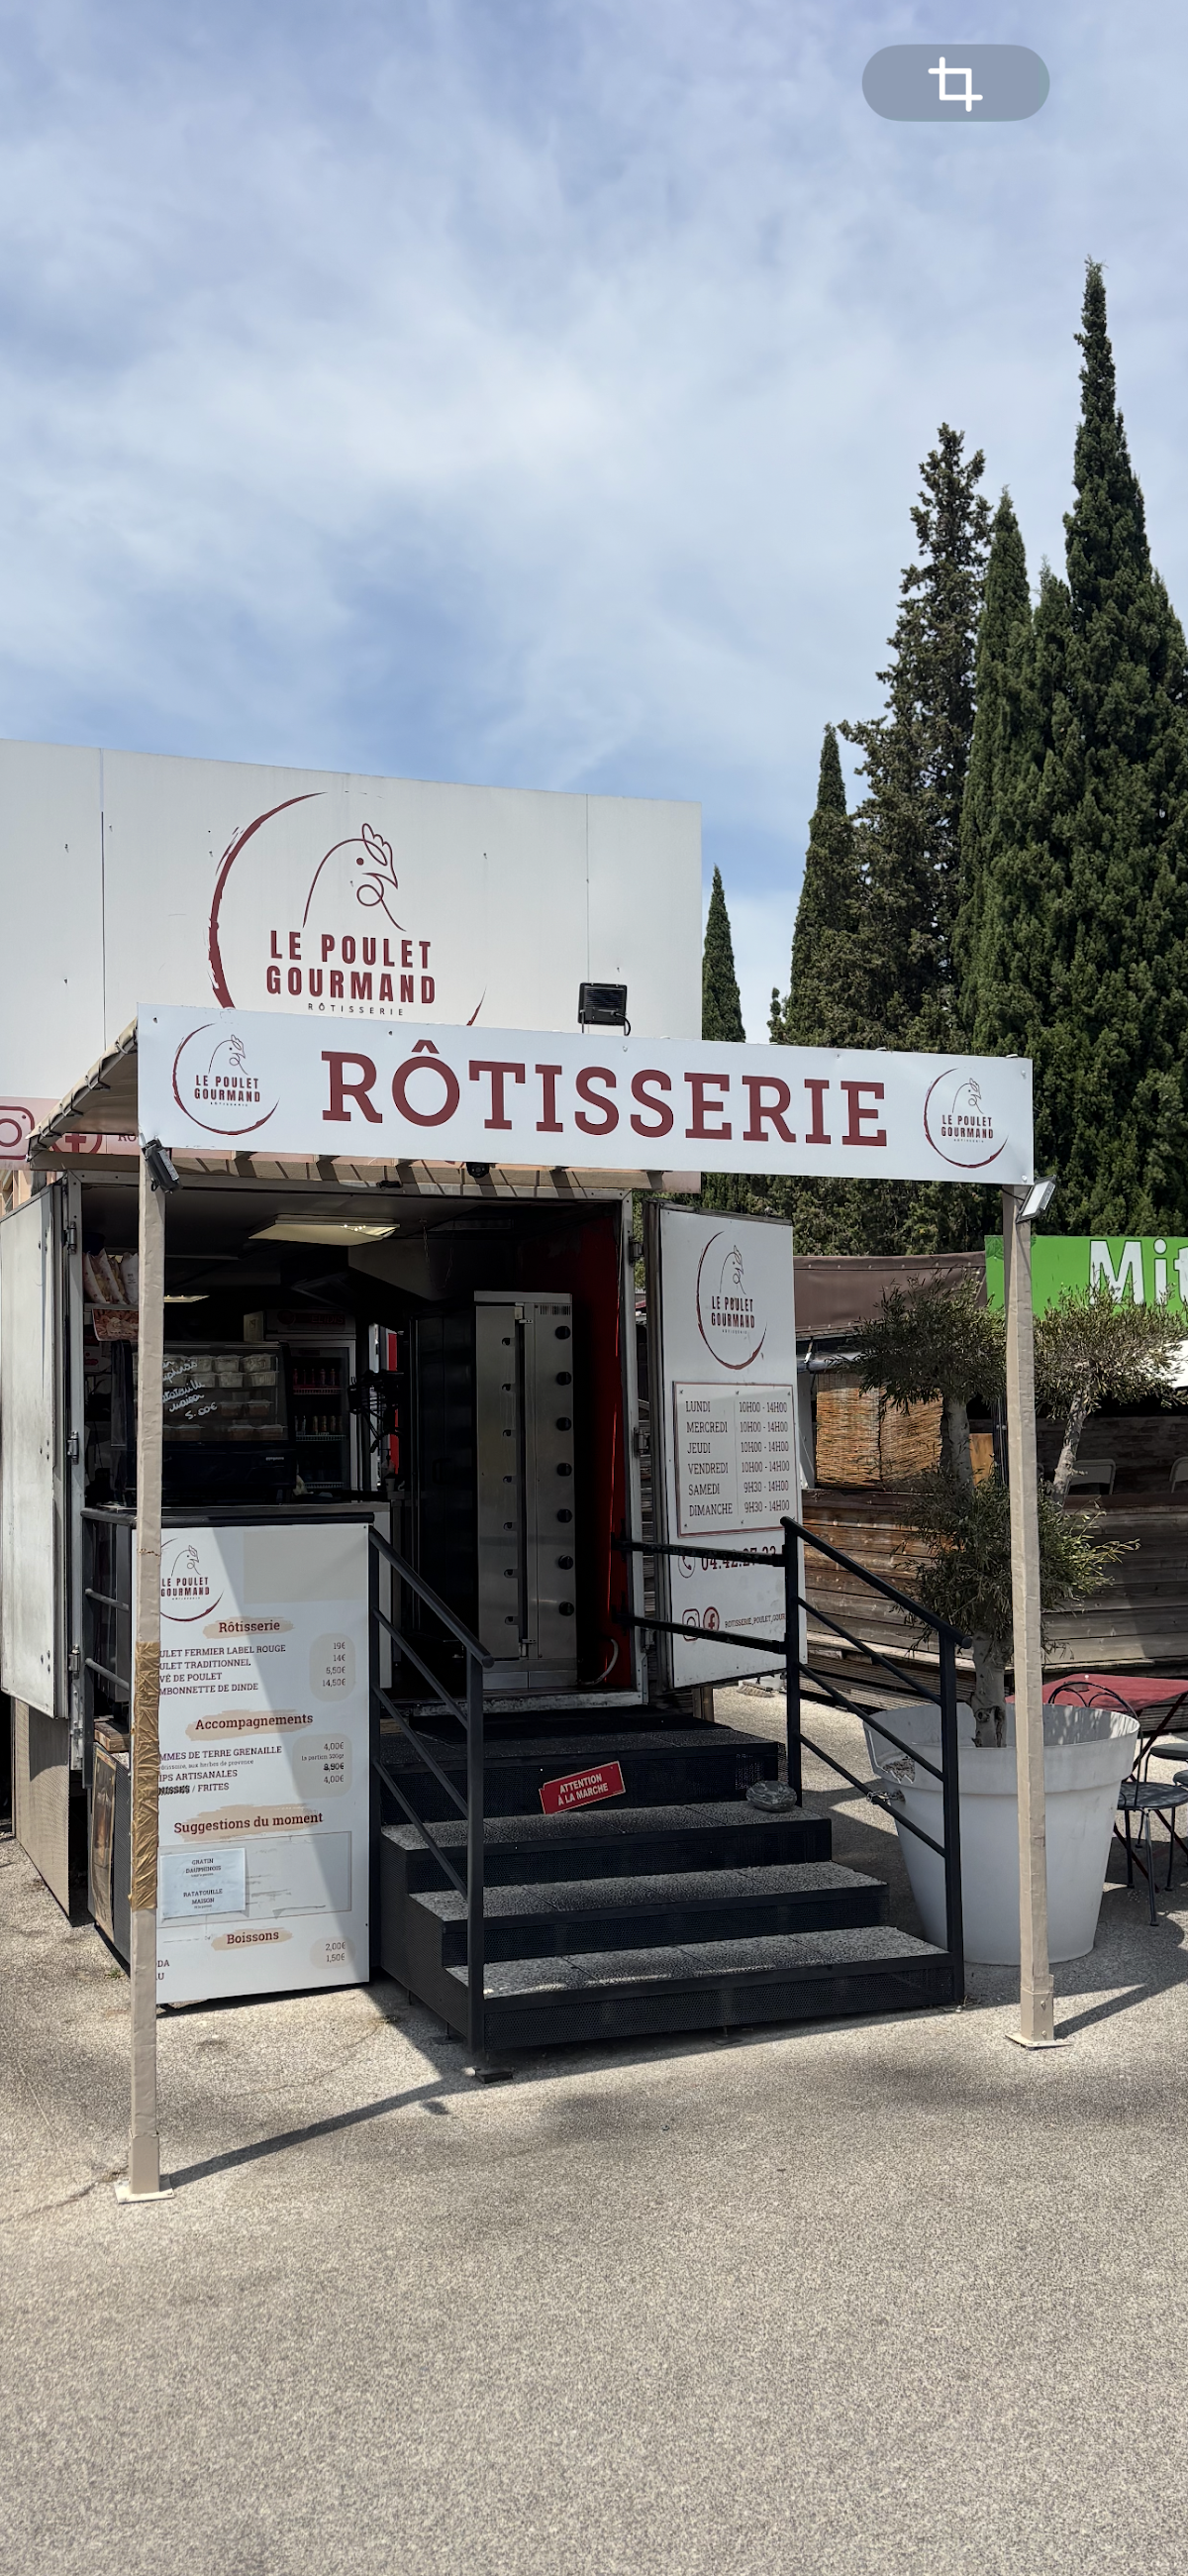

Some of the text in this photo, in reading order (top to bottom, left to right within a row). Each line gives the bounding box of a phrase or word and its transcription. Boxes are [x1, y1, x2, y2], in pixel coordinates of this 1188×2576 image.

[270, 930, 431, 969] LE POULET
[266, 966, 435, 1003] GOURMAND
[308, 1002, 403, 1015] RÔTISSERIE
[196, 1075, 258, 1089] LE POULET
[194, 1088, 260, 1102] GOURMAND
[321, 1039, 887, 1147] RÔTISSERIE
[942, 1114, 992, 1127] LE POULET
[941, 1126, 993, 1139] GOURMAND
[712, 1295, 753, 1312] LE POULET
[711, 1312, 754, 1329] GOURMAND
[685, 1401, 711, 1412] LUNDI
[739, 1401, 760, 1412] 10H00
[766, 1401, 787, 1412] 14H00
[686, 1421, 728, 1433] MERCREDI
[740, 1421, 761, 1433] 10H00
[767, 1421, 788, 1432] 14H00
[687, 1442, 711, 1454] JEUDI
[741, 1441, 762, 1453] 10H00
[768, 1441, 789, 1452] 14H00
[687, 1462, 729, 1475] VENDREDI
[742, 1461, 762, 1473] 10H00
[769, 1461, 790, 1472] 14H00
[688, 1483, 720, 1495] SAMEDI
[743, 1482, 762, 1494] 9H30
[768, 1480, 789, 1492] 14H00
[689, 1502, 733, 1517] DIMANCHE
[744, 1500, 763, 1513] 9H30
[769, 1499, 790, 1511] 14H00
[161, 1577, 209, 1587] LE POULET
[160, 1587, 210, 1597] GOURMAND
[219, 1619, 280, 1633] Rôtisserie
[159, 1644, 286, 1658] ULET FERMIER LABEL ROUGE
[184, 1659, 251, 1670] TRADITIONNEL
[159, 1674, 171, 1683] VÉ
[187, 1672, 222, 1682] POULET
[159, 1685, 216, 1696] MBONNETTE
[232, 1683, 258, 1692] DINDE
[195, 1714, 313, 1730] Accompagnements
[160, 1746, 282, 1761] MMES DE TERRE GRENAILLE
[175, 1770, 238, 1781] ARTISANALES
[158, 1785, 190, 1796] NISSES
[198, 1783, 230, 1793] FRITES
[559, 1773, 602, 1795] ATTENTION
[565, 1794, 575, 1803] LA
[576, 1783, 609, 1801] MARCHE
[173, 1812, 323, 1835] Suggestions du moment
[183, 1888, 223, 1898] RATATOUILLE
[227, 1931, 279, 1945] Boissons
[156, 1959, 170, 1968] DA
